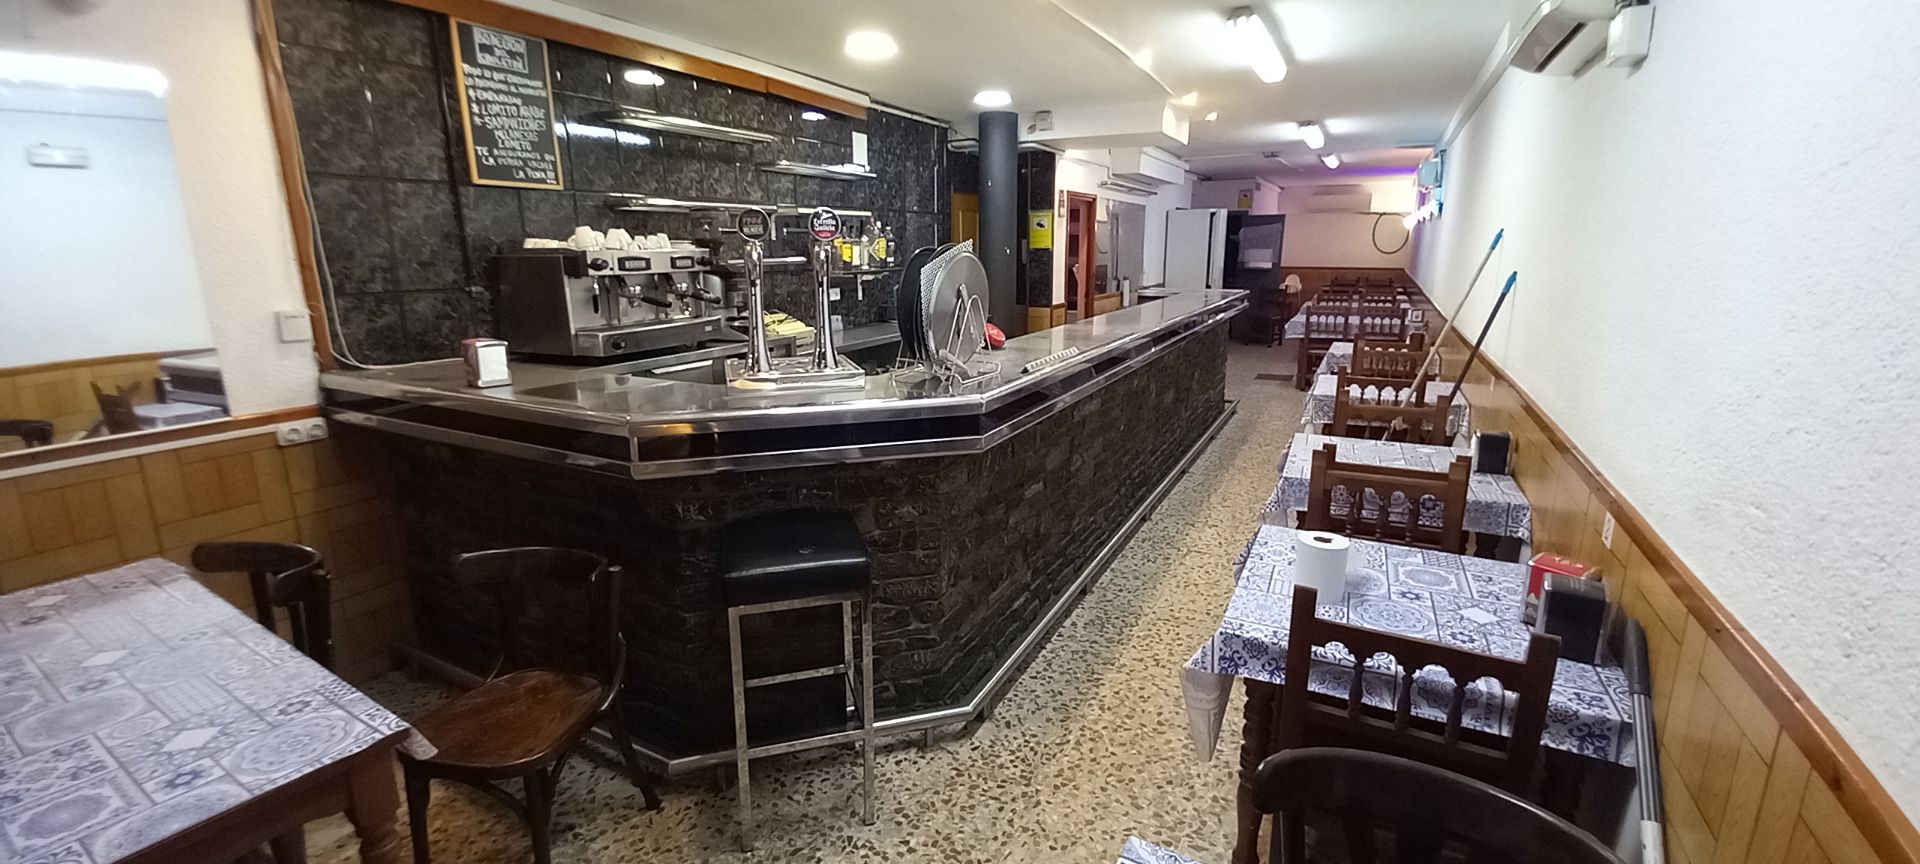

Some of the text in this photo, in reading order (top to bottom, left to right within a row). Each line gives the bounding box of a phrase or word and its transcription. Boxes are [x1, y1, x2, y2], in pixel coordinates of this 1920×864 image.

[481, 103, 518, 117] LOMITO
[498, 139, 532, 151] LOMITO
[475, 146, 489, 156] TE
[482, 156, 496, 166] LA
[512, 168, 526, 179] LA
